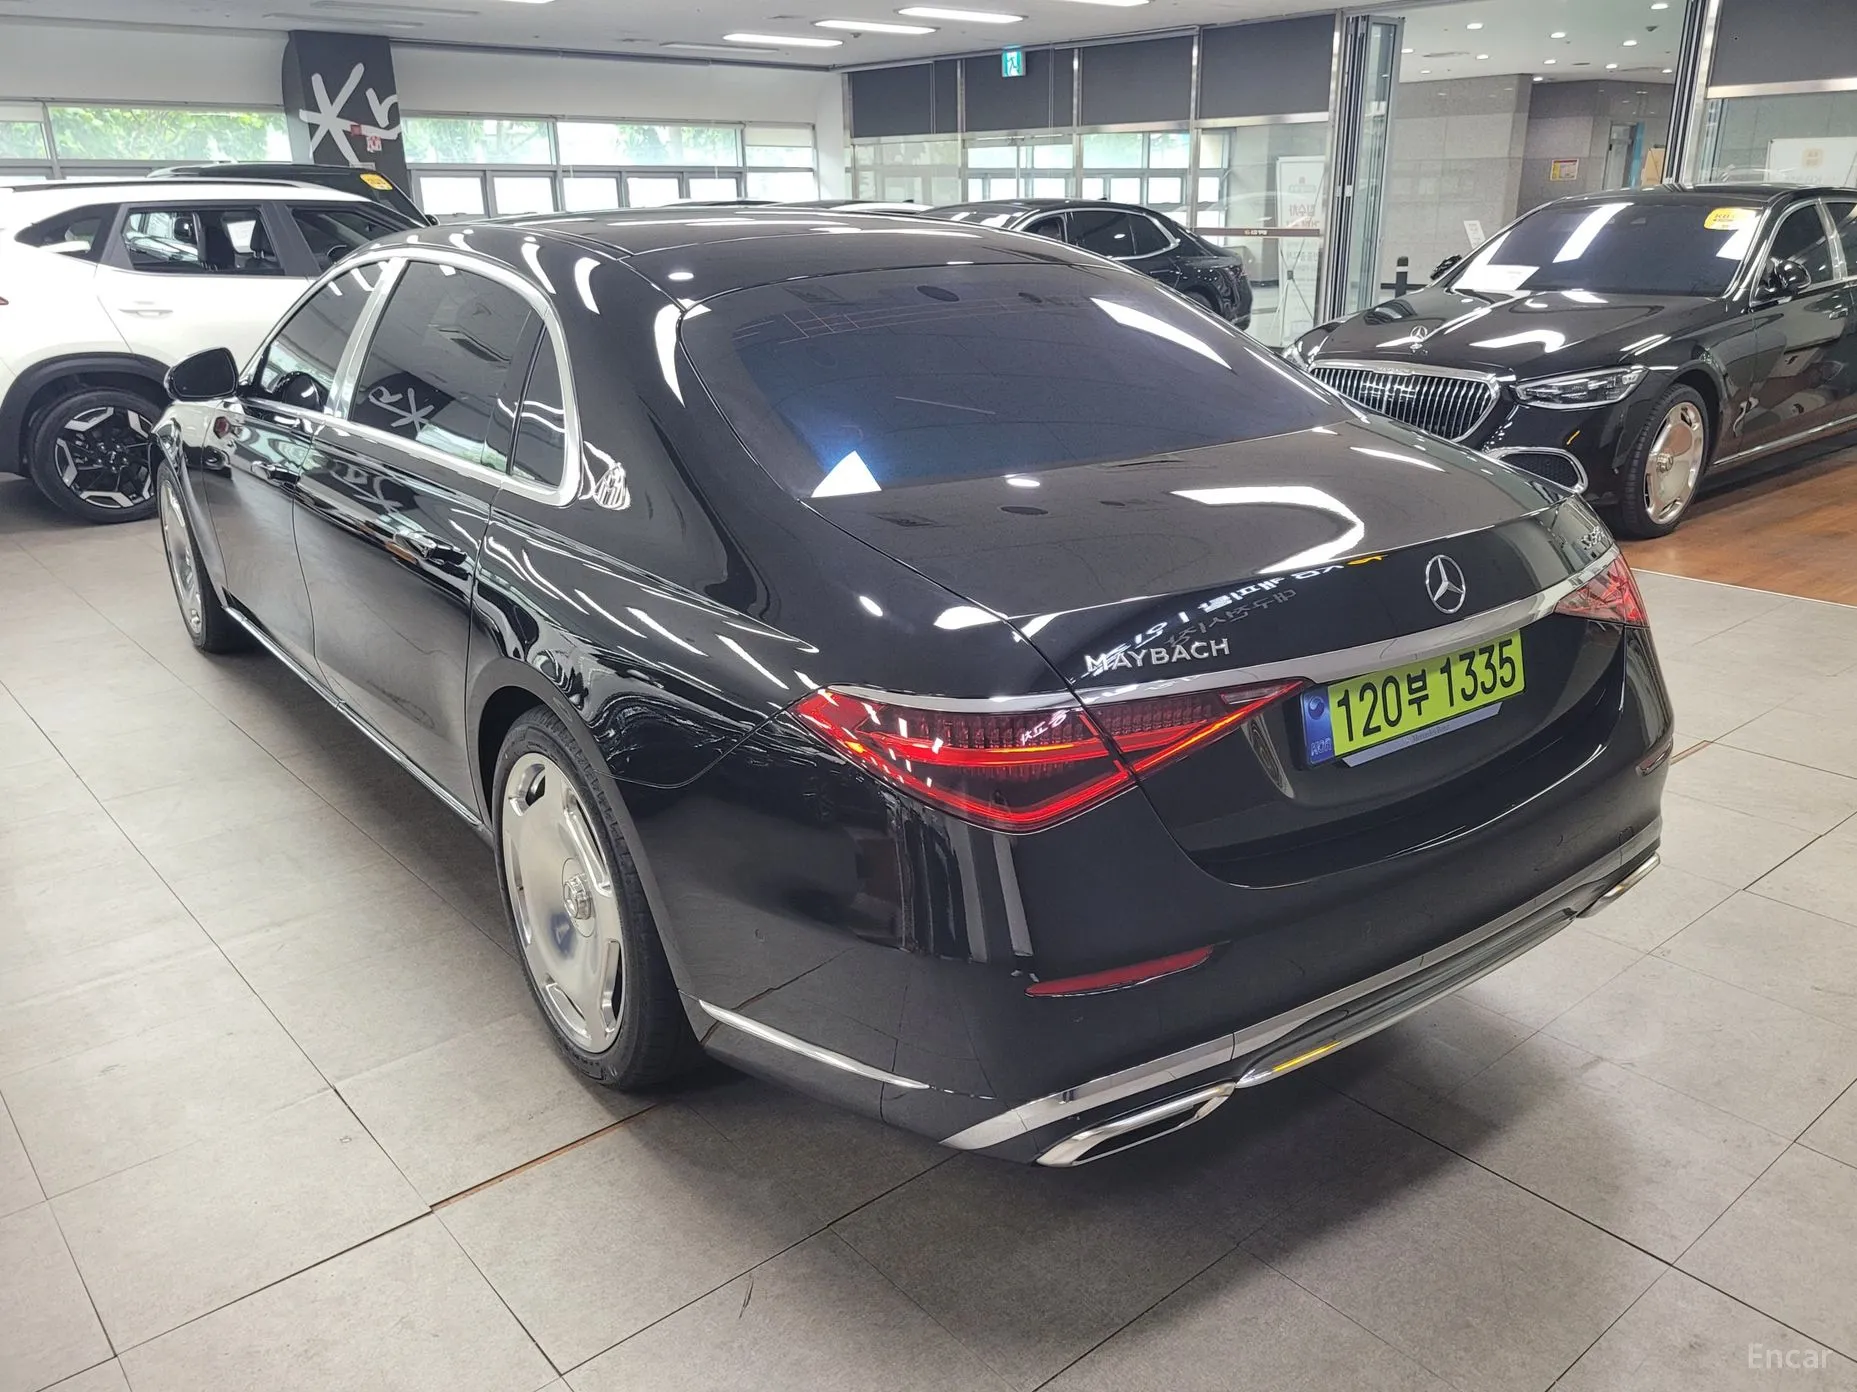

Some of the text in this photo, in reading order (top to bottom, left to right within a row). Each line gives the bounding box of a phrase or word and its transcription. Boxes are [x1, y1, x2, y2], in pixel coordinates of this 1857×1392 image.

[1084, 638, 1230, 672] MAYBACH
[1337, 638, 1516, 742] 120부 1335
[1311, 737, 1332, 756] KOR
